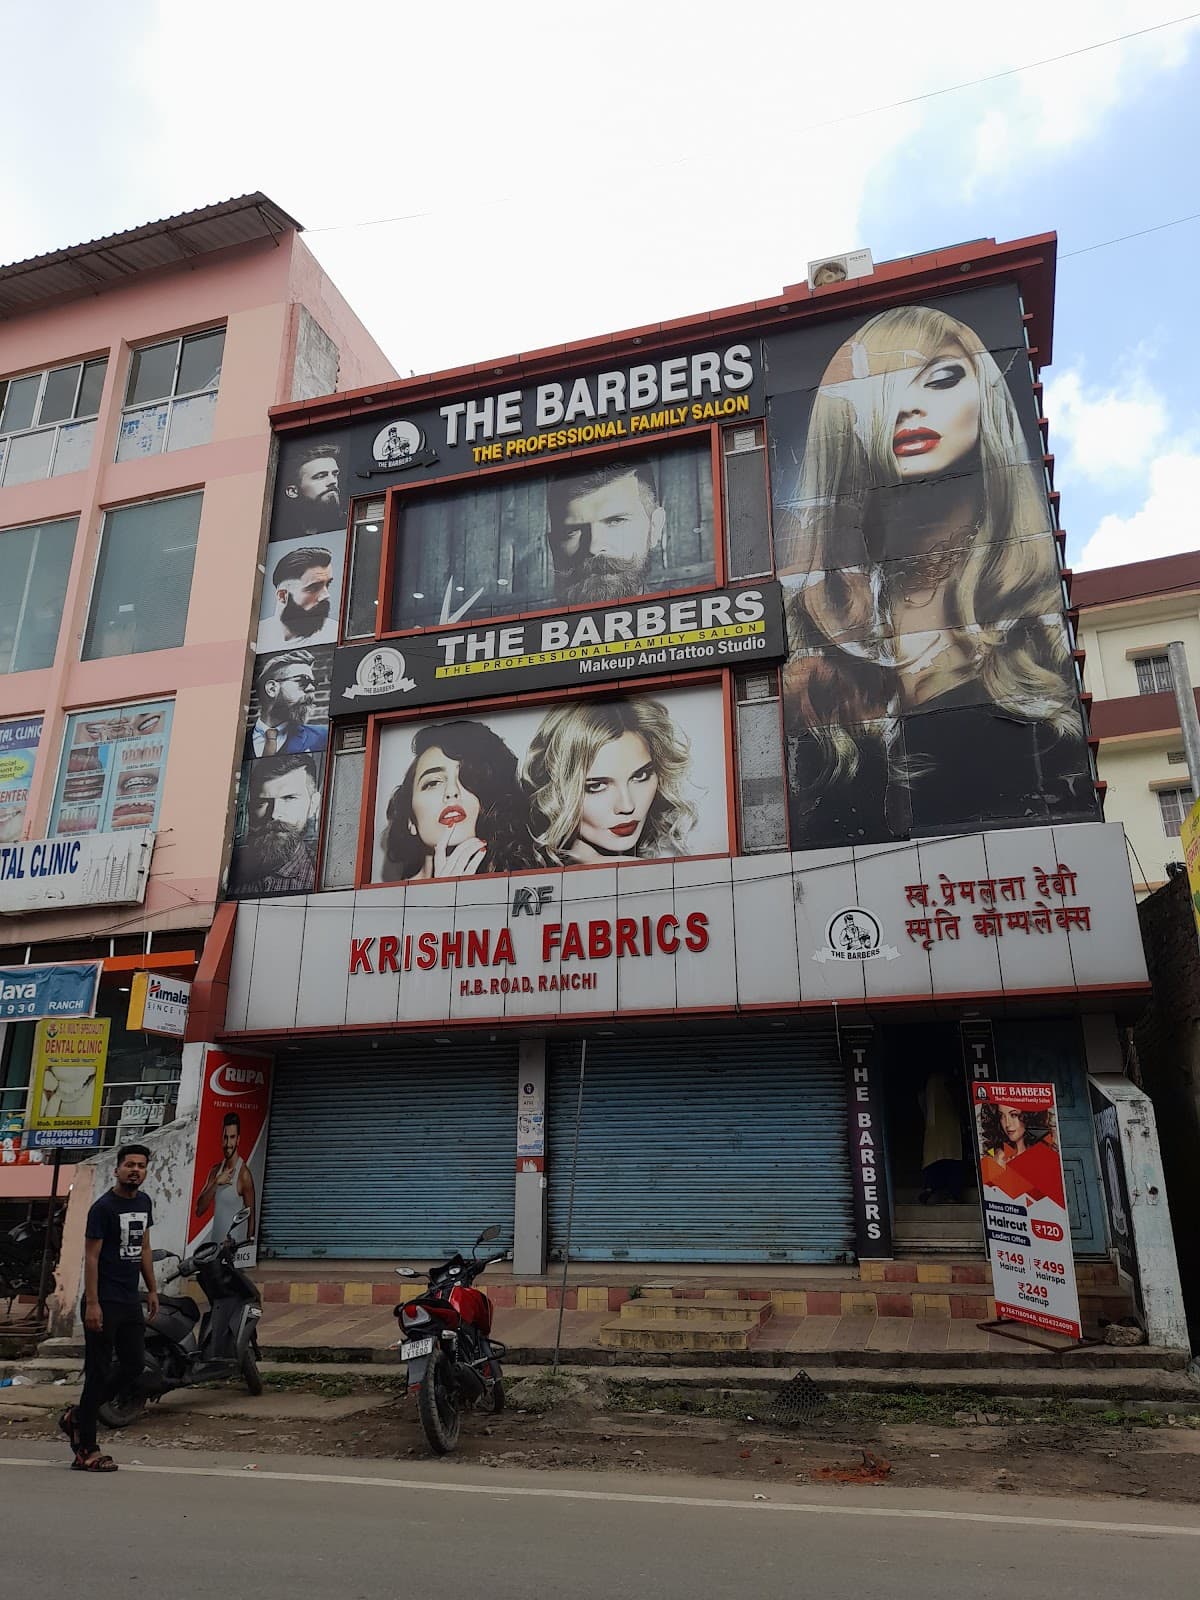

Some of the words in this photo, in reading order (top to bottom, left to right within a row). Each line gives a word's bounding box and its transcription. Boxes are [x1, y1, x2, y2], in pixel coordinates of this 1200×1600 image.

[440, 390, 523, 447] THE
[536, 344, 754, 429] BARBERS
[472, 442, 503, 464] THE
[506, 420, 627, 458] PROFESSIONAL
[630, 405, 688, 433] FAMILY
[691, 394, 749, 420] SALON
[437, 626, 525, 666] THE
[541, 590, 765, 651] BARBERS
[443, 664, 471, 675] THE
[483, 644, 611, 670] PROFESSIONAL
[624, 634, 686, 649] FAMILY
[699, 623, 757, 640] SALON
[579, 656, 635, 674] Makeup
[638, 649, 666, 666] And
[669, 645, 714, 661] Tattoo
[717, 636, 766, 654] Studio
[30, 841, 81, 878] CLINIC
[349, 927, 517, 975] KRISHNA
[542, 911, 710, 964] FABRICS
[831, 950, 846, 959] THE
[847, 948, 881, 960] BARBERS
[538, 972, 598, 992] RANCHI
[48, 999, 84, 1010] RANCHI
[45, 1039, 75, 1054] DENTAL
[77, 1039, 103, 1054] CLINIC
[225, 1067, 265, 1085] RUPA
[853, 1048, 870, 1102] THE
[990, 1086, 1007, 1096] THE
[1009, 1086, 1052, 1097] BARBERS
[857, 1112, 881, 1240] BARBERS
[1005, 1205, 1020, 1213] Offer
[988, 1215, 1028, 1232] Haircut
[991, 1232, 1011, 1241] Ladies
[1010, 1236, 1026, 1245] Offer
[999, 1261, 1026, 1274] Haircut
[1036, 1271, 1066, 1285] Hairspa
[1018, 1292, 1050, 1309] Cleanup
